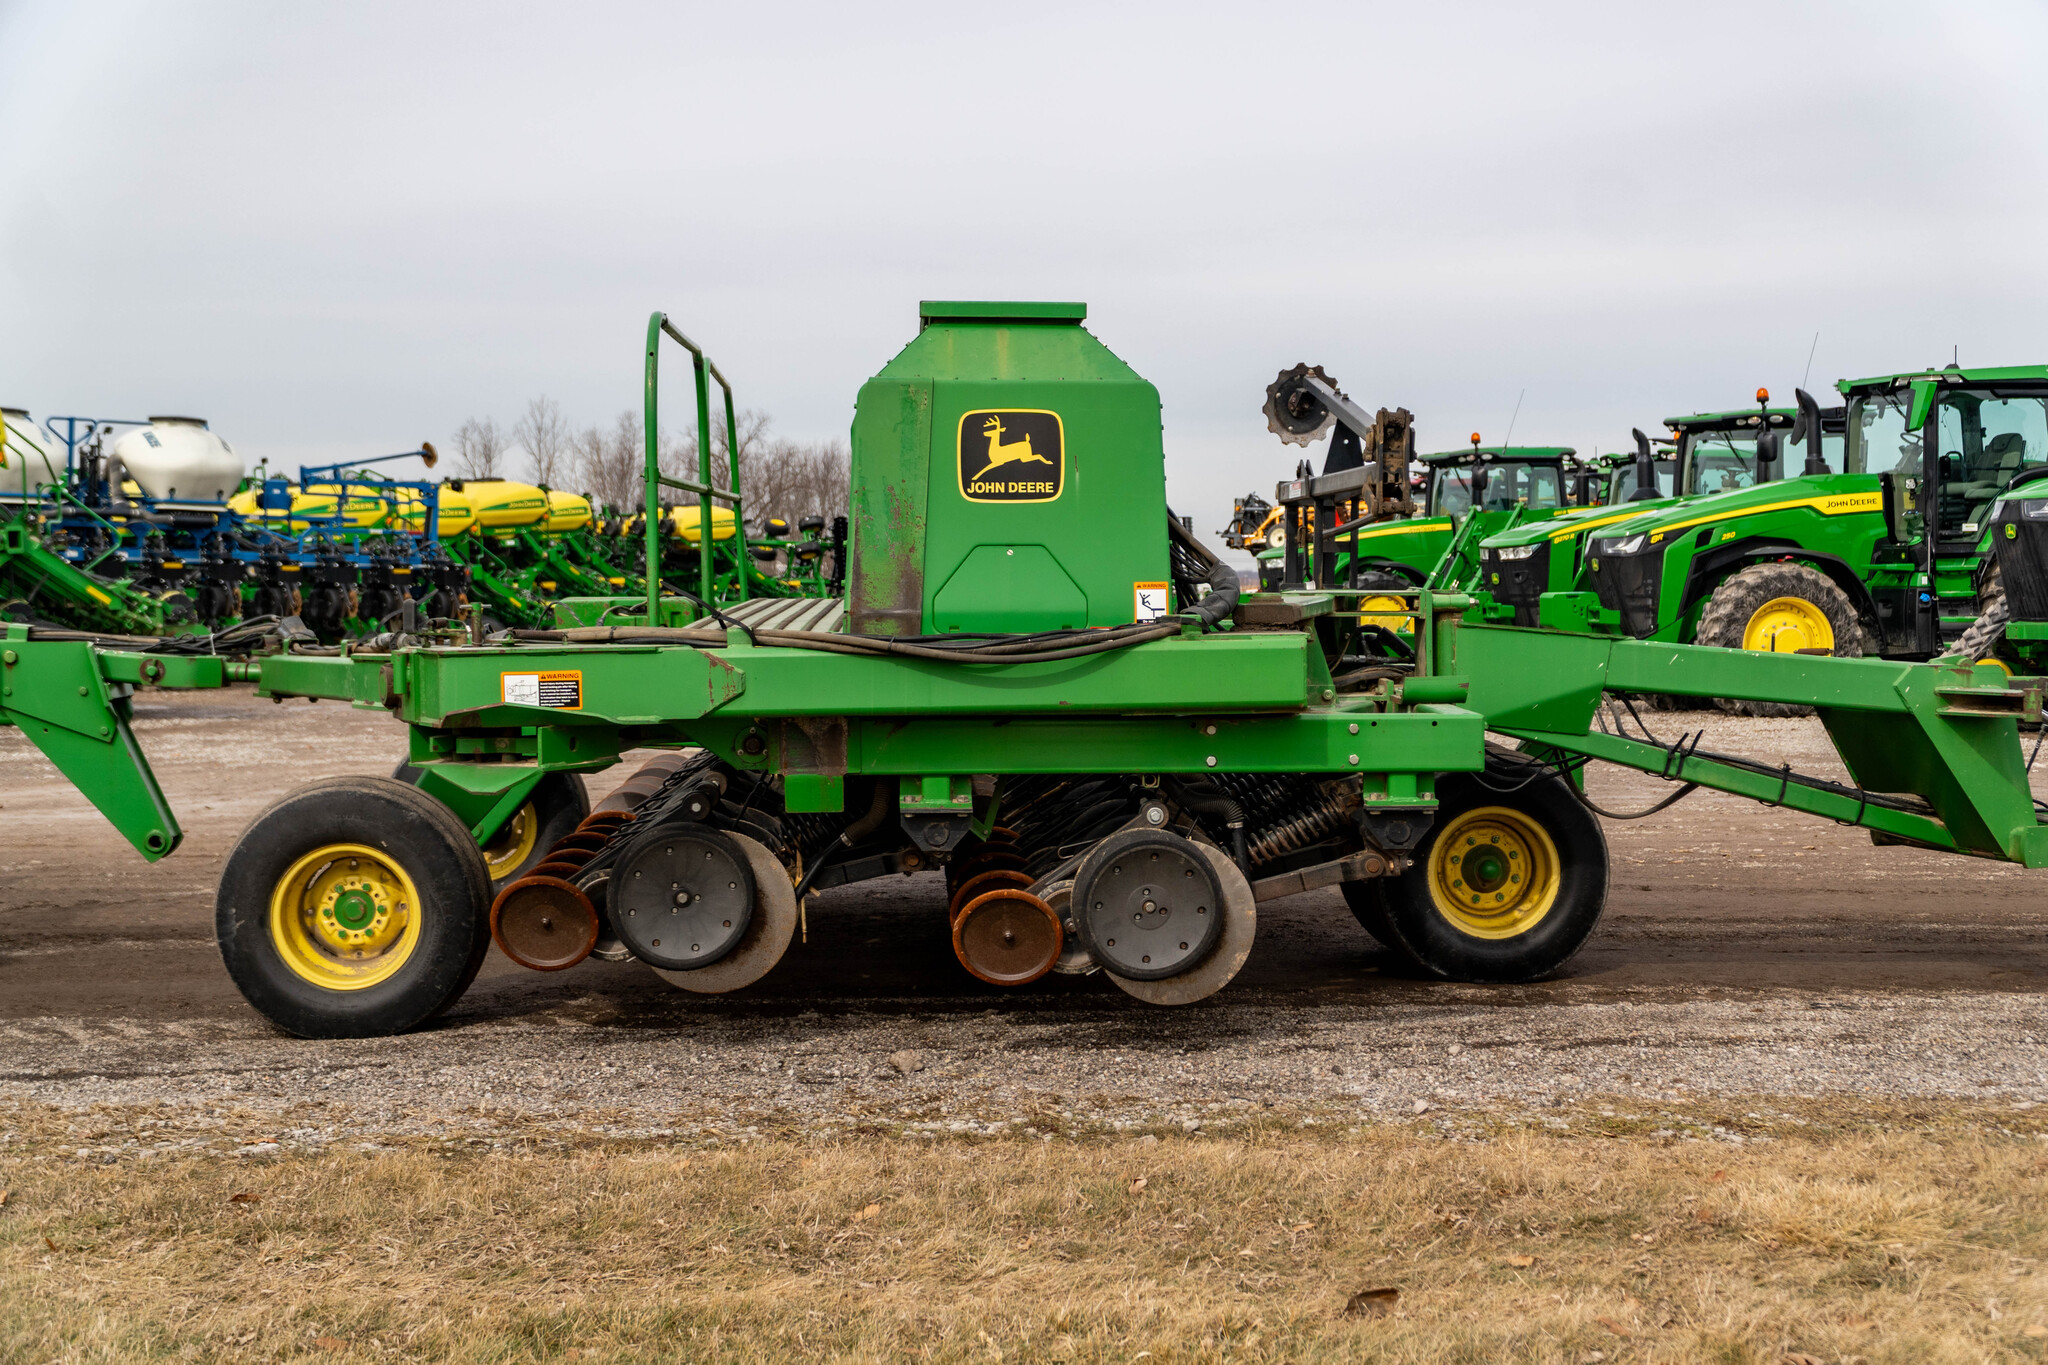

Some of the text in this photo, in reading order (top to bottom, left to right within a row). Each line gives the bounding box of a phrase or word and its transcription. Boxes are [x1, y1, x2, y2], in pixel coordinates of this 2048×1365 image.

[967, 482, 1054, 493] JOHN DEERE
[328, 503, 350, 512] JON
[1826, 498, 1877, 508] JOHN DEERE
[1650, 533, 1664, 544] 8R
[1721, 531, 1736, 541] 250
